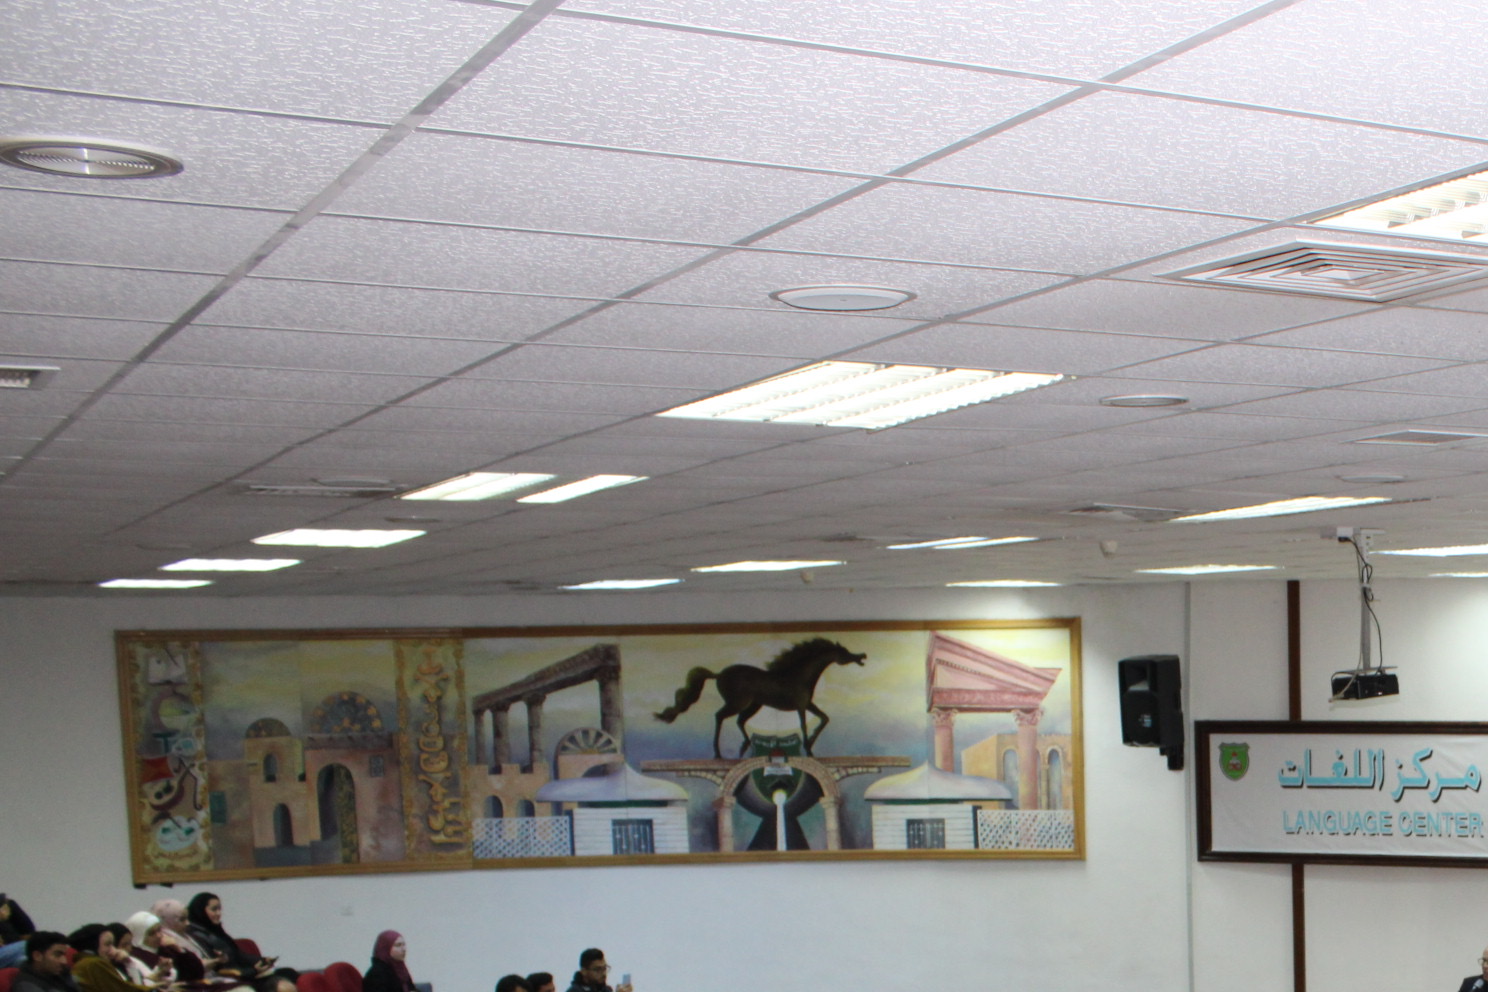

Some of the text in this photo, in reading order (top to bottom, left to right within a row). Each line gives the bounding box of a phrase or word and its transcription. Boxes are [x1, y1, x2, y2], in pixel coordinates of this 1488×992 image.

[1278, 748, 1481, 801] مركز اللغات
[1283, 810, 1485, 839] LANGUAGE CENTER
